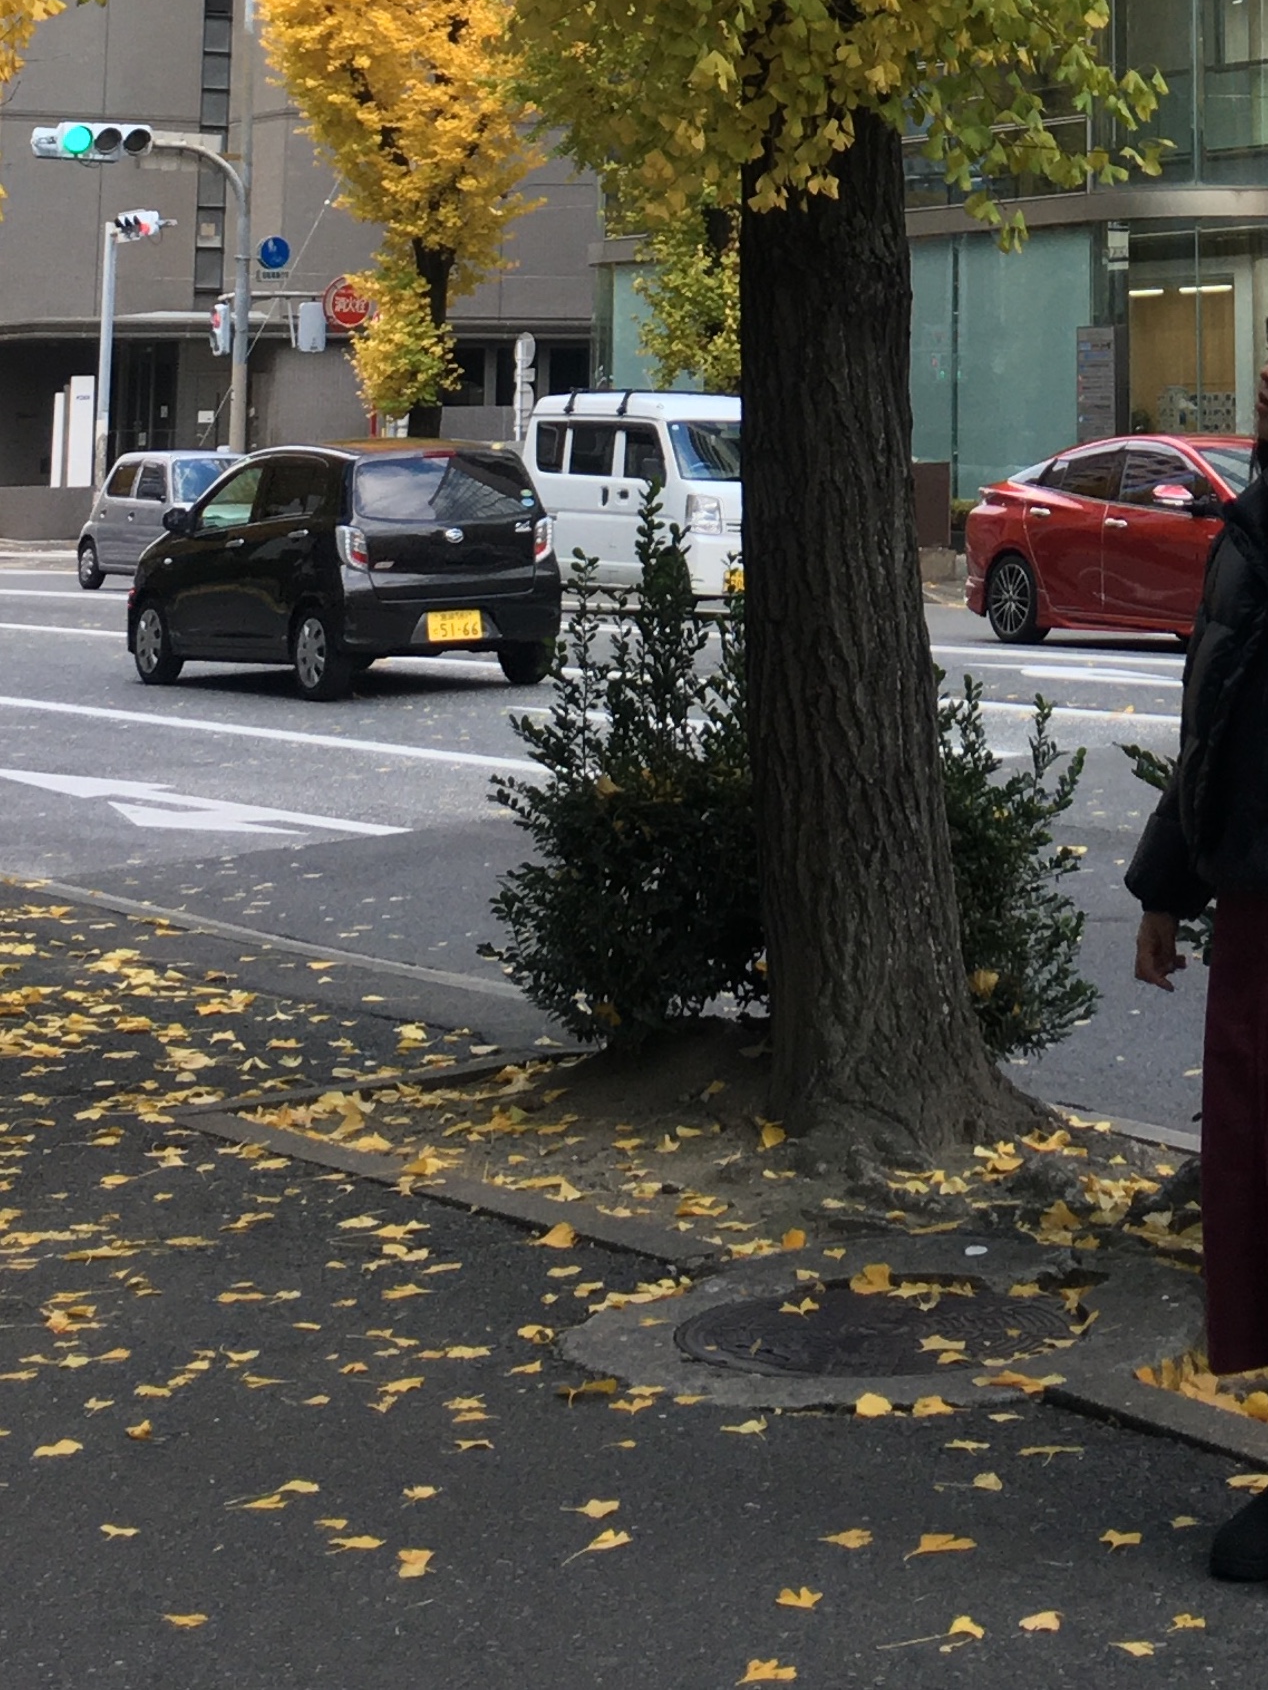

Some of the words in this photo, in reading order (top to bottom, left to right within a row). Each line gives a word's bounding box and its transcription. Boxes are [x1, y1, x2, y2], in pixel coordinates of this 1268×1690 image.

[334, 295, 367, 314] 消火栓
[440, 621, 479, 638] 51-66
